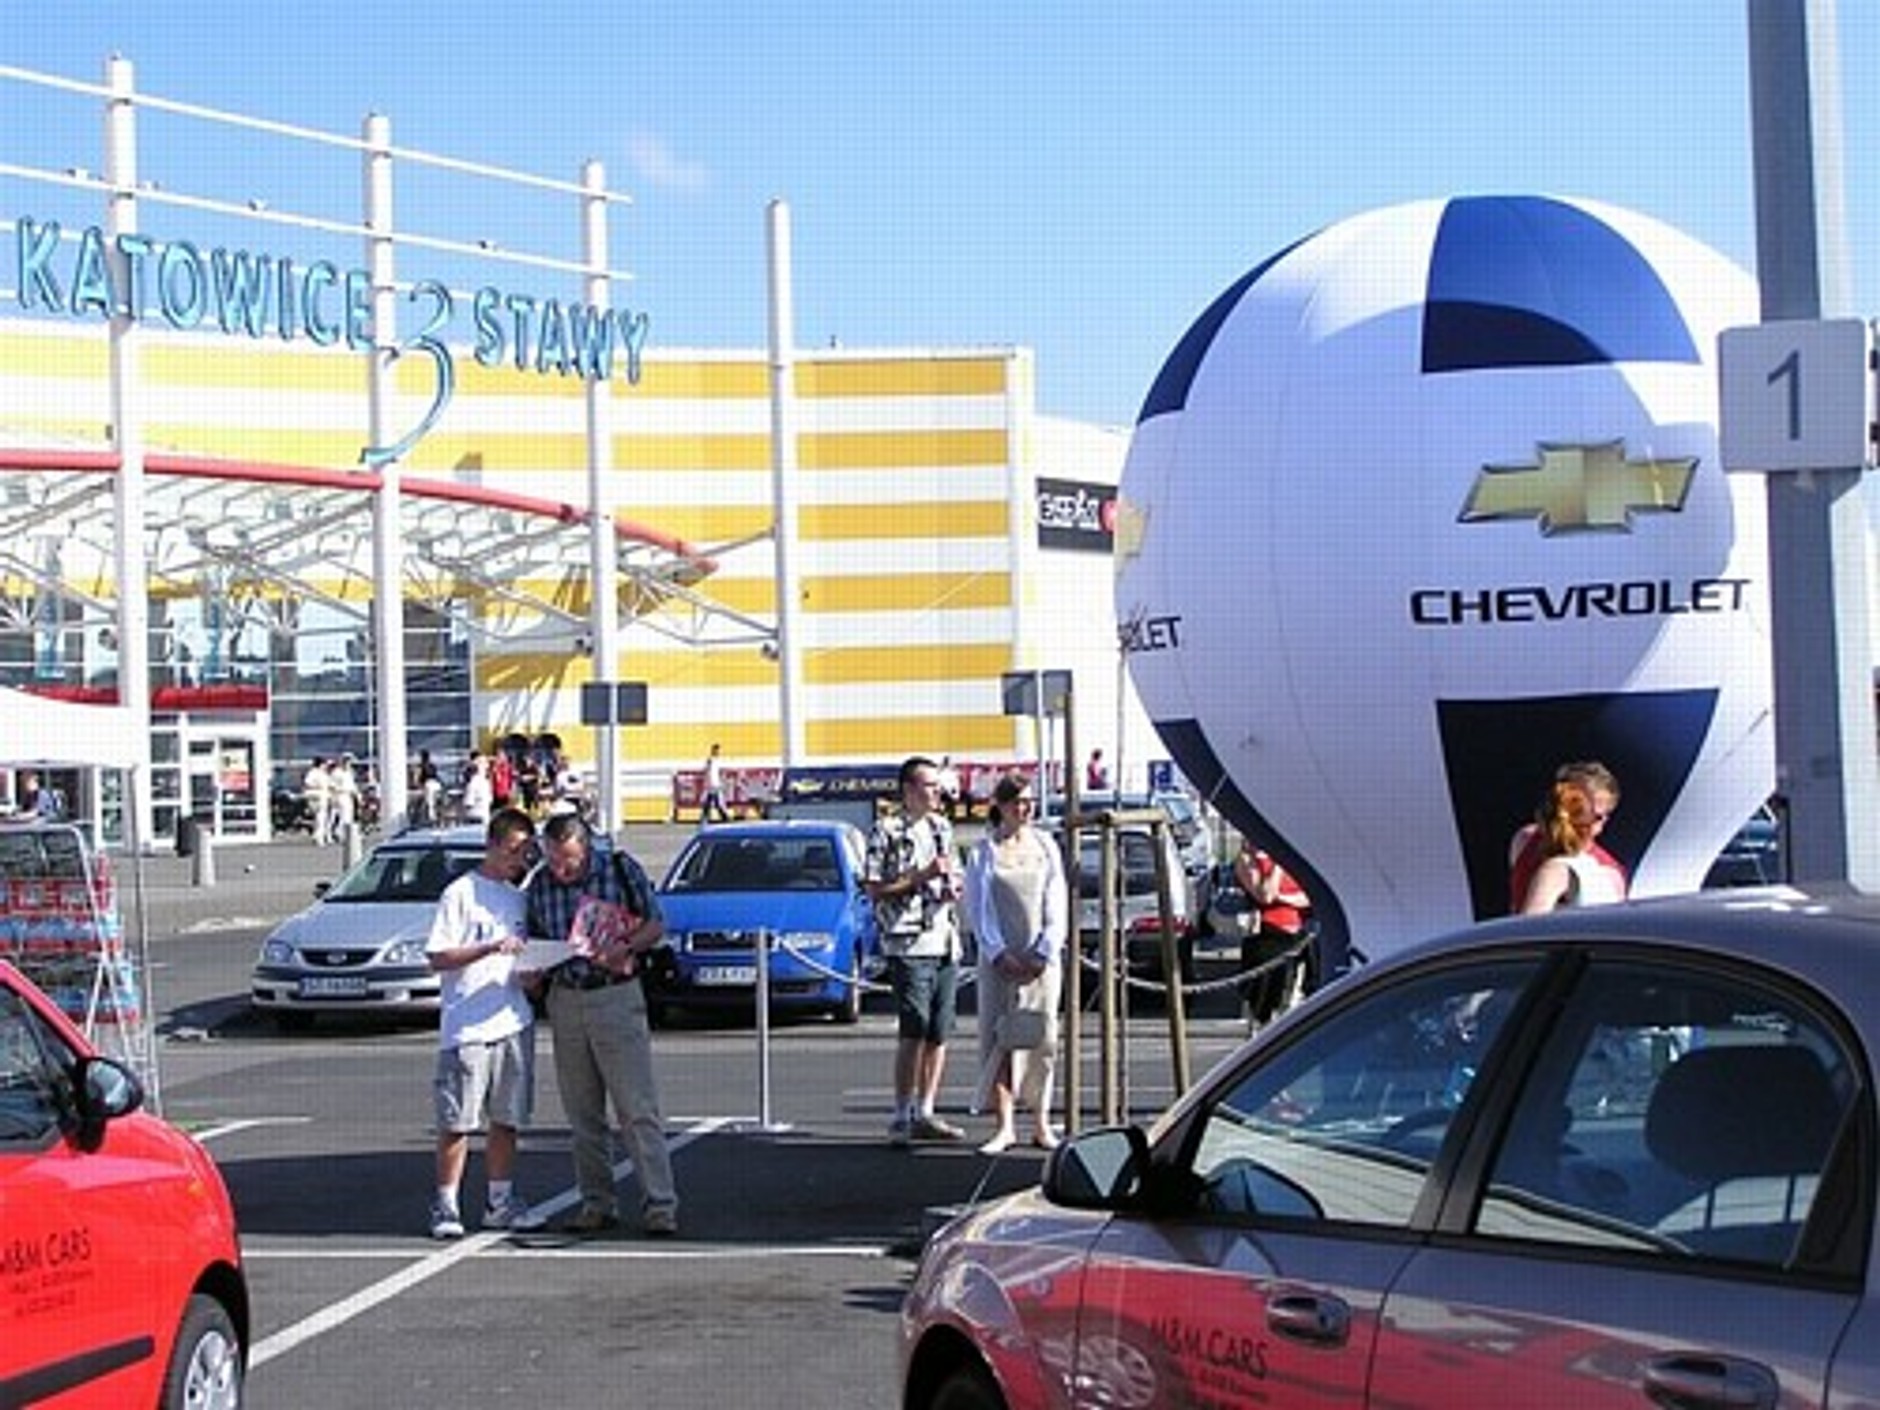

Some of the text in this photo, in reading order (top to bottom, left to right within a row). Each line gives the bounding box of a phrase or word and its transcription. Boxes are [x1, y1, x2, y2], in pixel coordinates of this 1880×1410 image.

[16, 215, 649, 466] KATOWICE 3 STAWY
[1767, 350, 1801, 441] 1
[1410, 579, 1751, 624] CHEVROLET
